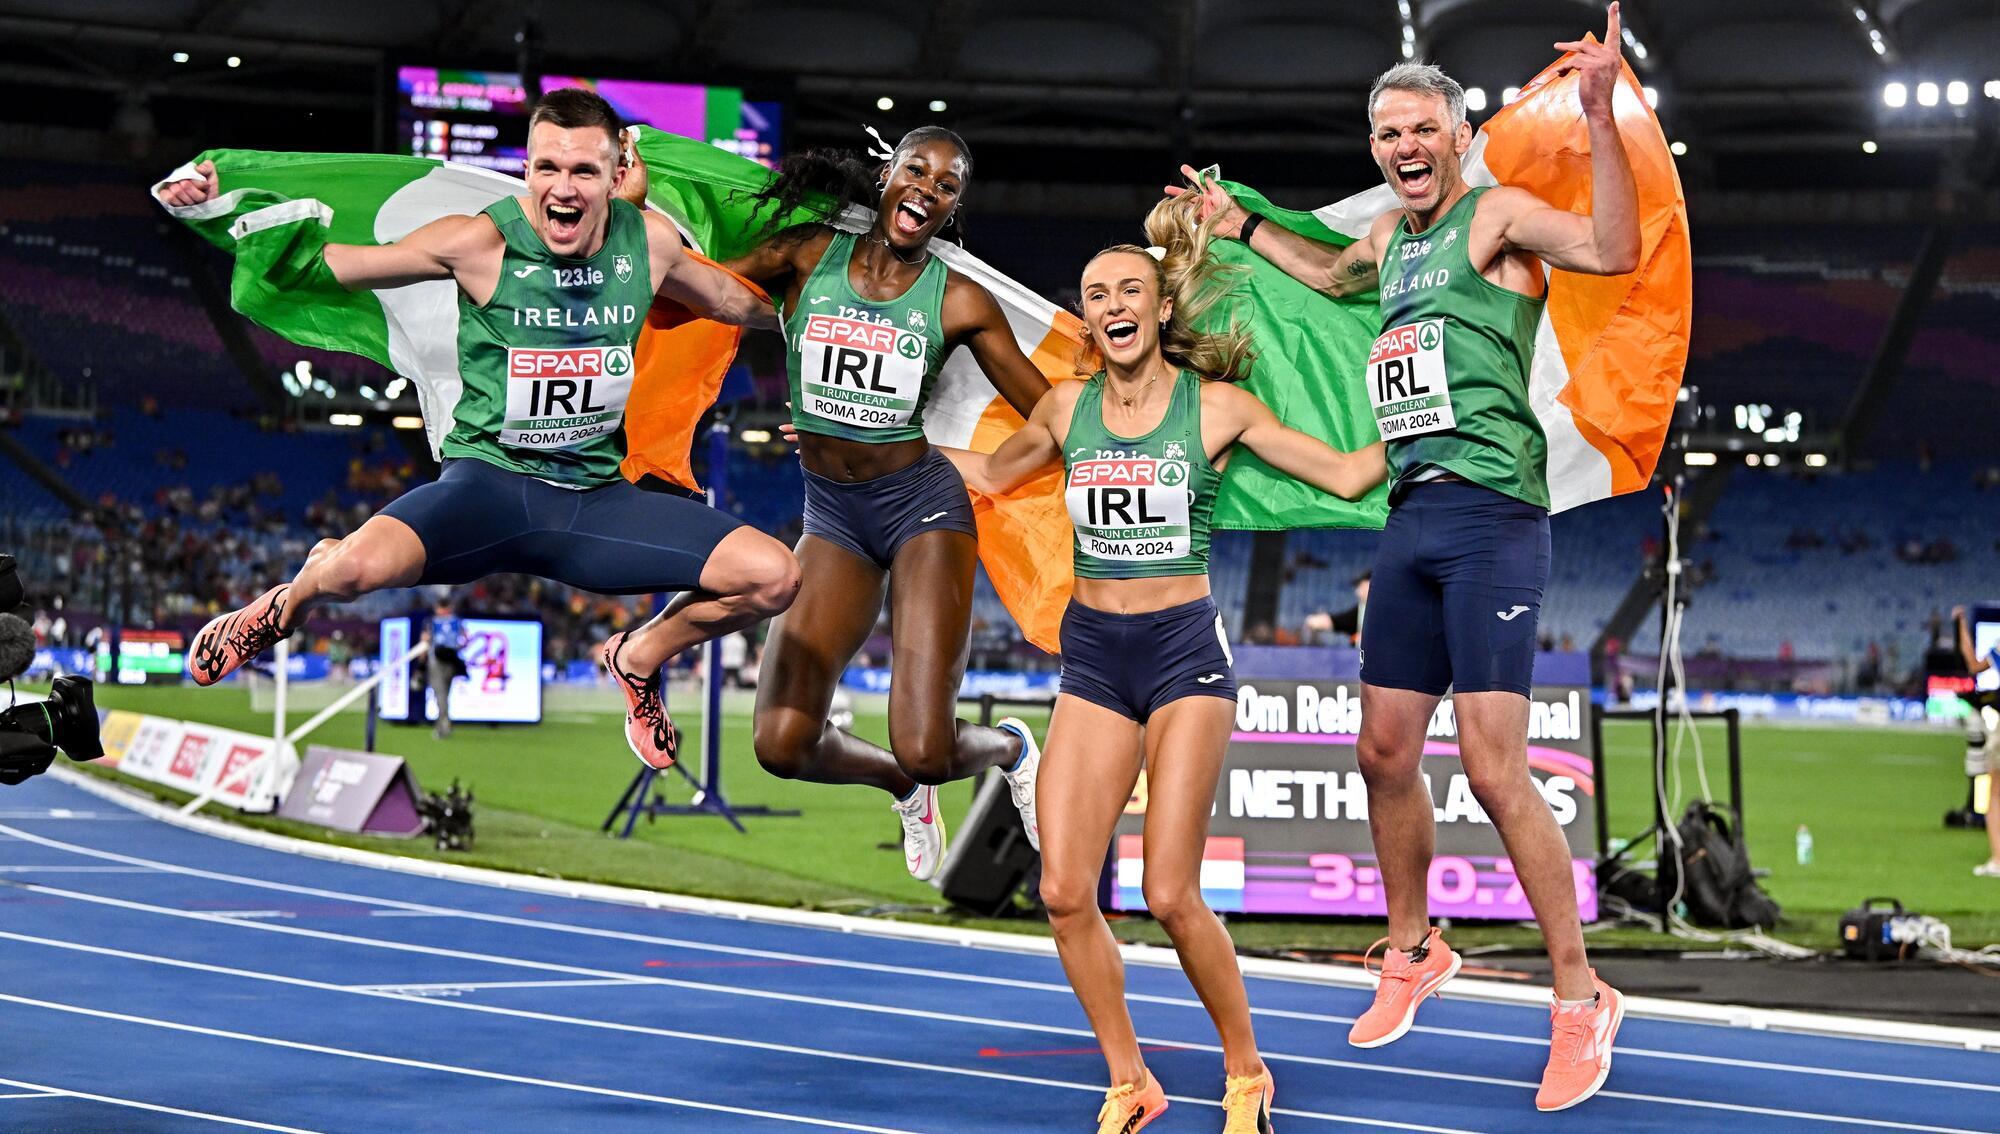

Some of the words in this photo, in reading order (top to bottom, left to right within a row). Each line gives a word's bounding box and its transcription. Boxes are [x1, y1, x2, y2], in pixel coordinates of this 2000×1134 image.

[1401, 240, 1432, 261] 123.ie
[552, 266, 605, 288] 123.ie
[1381, 268, 1449, 303] RELAND
[513, 304, 636, 327] IRELAND
[838, 305, 894, 328] 123ie
[810, 320, 894, 350] SPAR
[1369, 329, 1417, 361] SPAR
[513, 352, 600, 375] SPAR
[820, 345, 897, 395] IRL
[1376, 356, 1430, 403] IRL
[528, 378, 606, 418] IRL
[827, 388, 850, 399] RUN
[815, 399, 857, 420] ROMA
[860, 409, 897, 424] 2024
[1385, 403, 1400, 415] RUN
[535, 418, 561, 429] RUN
[1382, 418, 1408, 434] ROMA
[1408, 411, 1441, 429] 2024
[518, 431, 566, 444] ROMA
[569, 425, 605, 441] 2024
[1073, 463, 1153, 484] SPAR
[1087, 487, 1167, 526] IRL
[1098, 528, 1121, 539] RUN
[1091, 539, 1133, 556] ROMA
[1135, 541, 1174, 556] 2024
[1296, 684, 1363, 734] Rela
[1527, 690, 1581, 740] nal
[1229, 768, 1579, 826] NETHLAS
